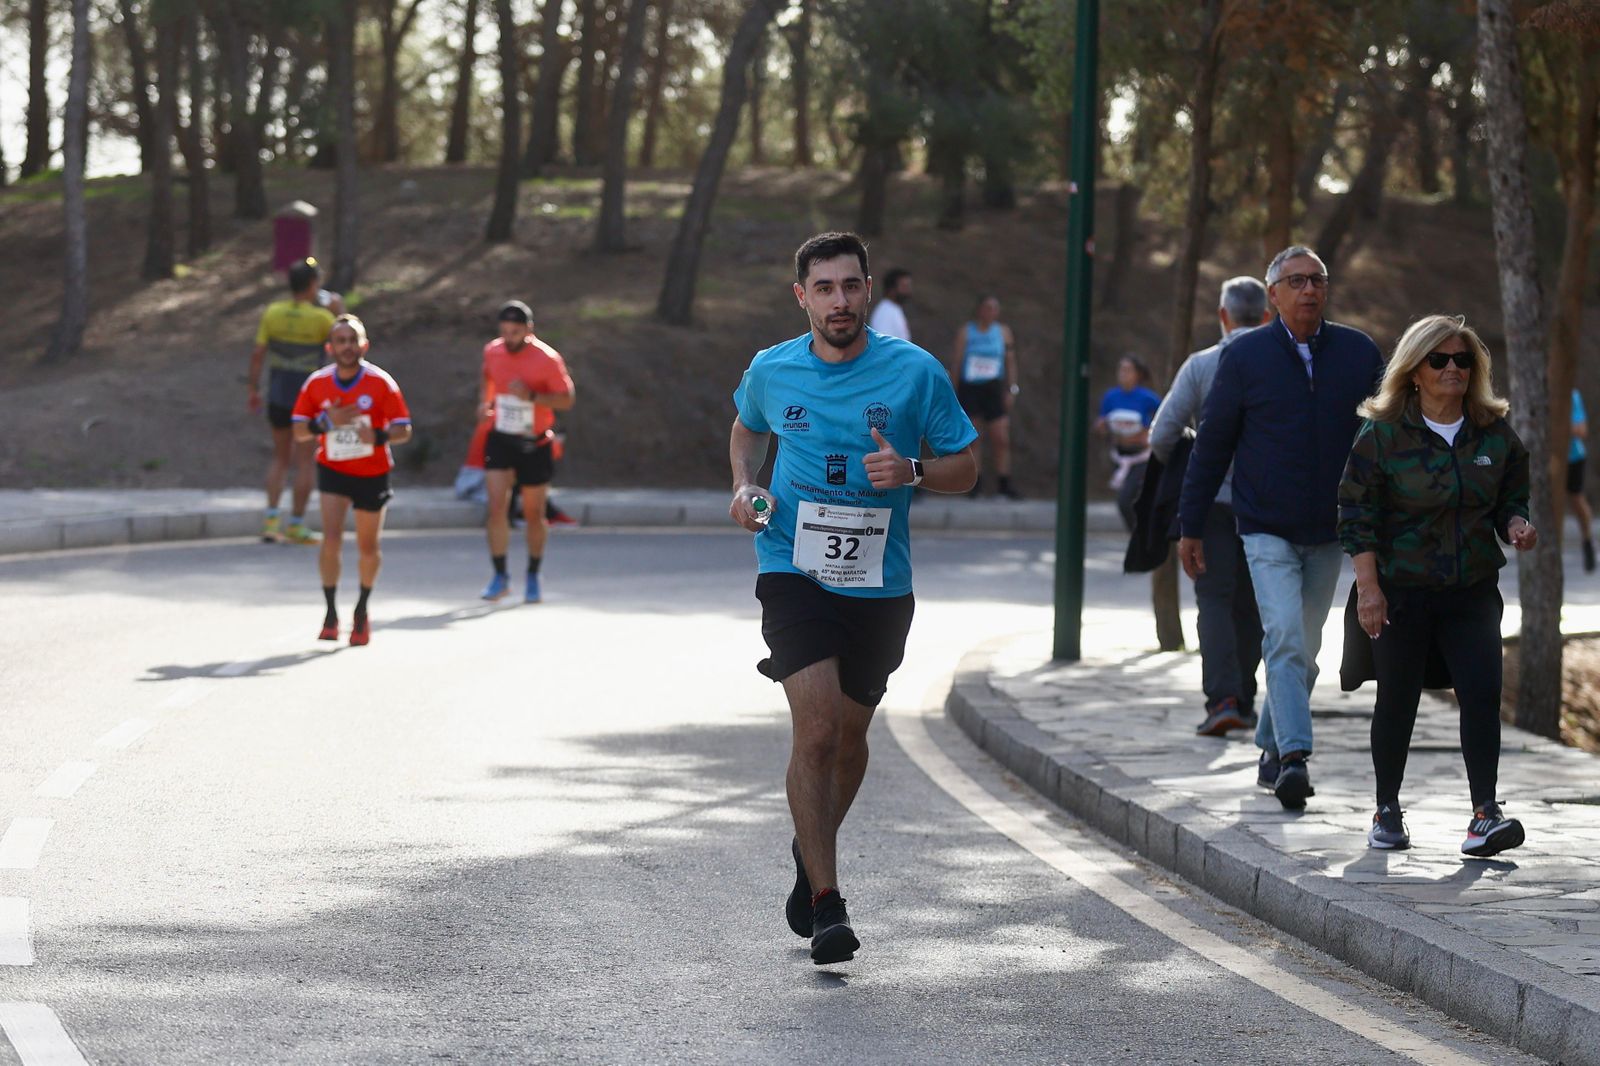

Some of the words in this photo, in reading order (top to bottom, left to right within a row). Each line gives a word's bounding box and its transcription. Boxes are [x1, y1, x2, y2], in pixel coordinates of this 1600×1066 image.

[790, 480, 843, 496] Ayuntamiento
[845, 489, 856, 497] de
[824, 535, 860, 560] 32
